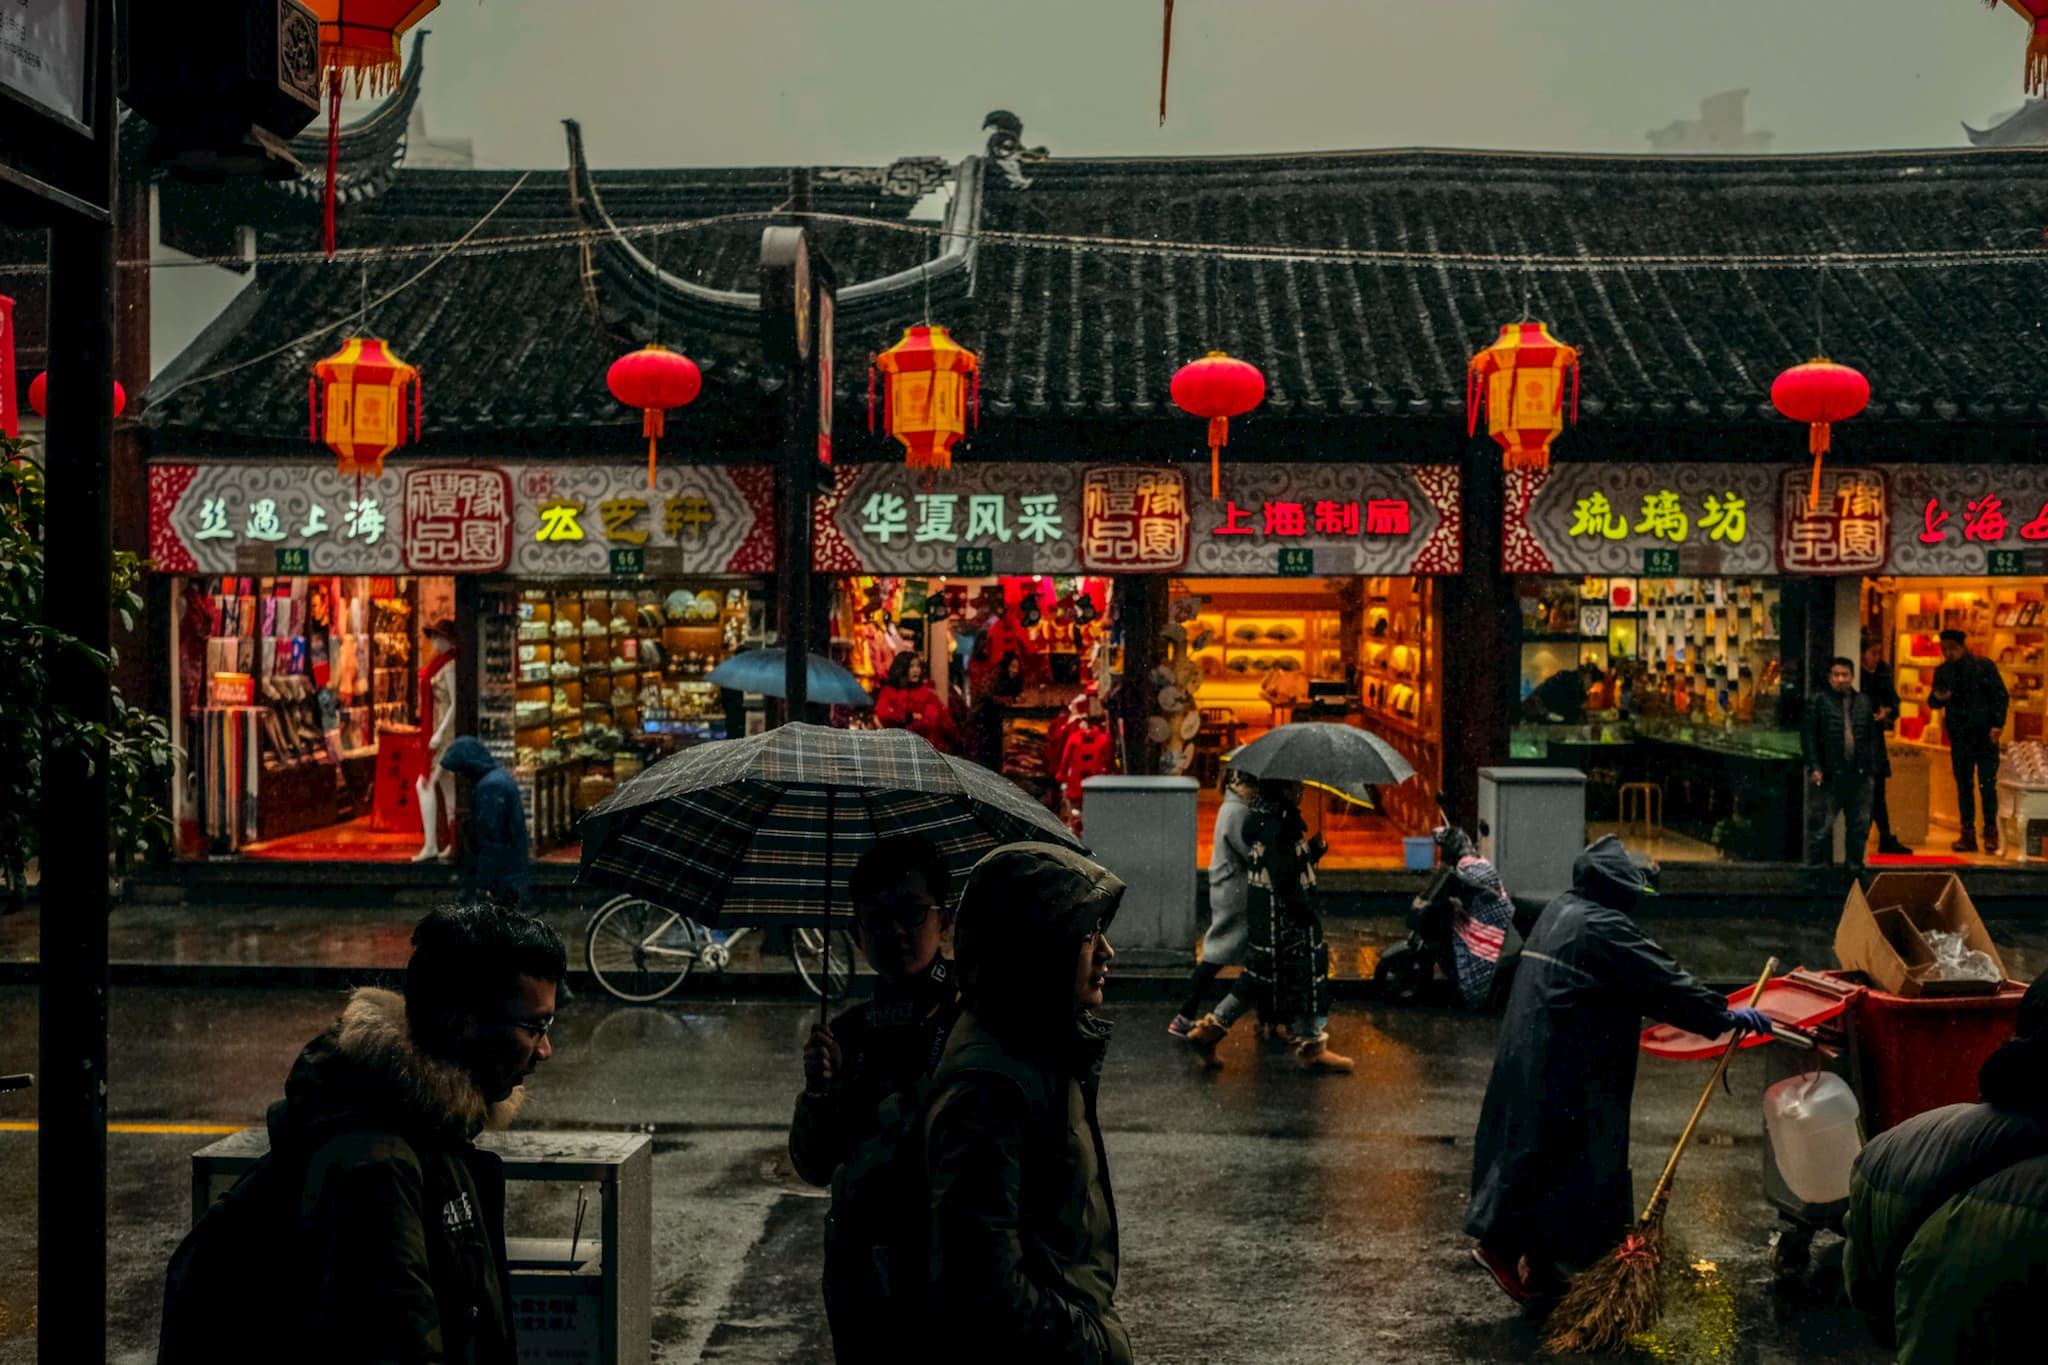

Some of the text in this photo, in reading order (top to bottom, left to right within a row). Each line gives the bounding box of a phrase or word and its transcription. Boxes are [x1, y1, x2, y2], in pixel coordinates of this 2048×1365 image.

[861, 492, 1063, 543] 华夏风采
[1213, 499, 1411, 536] 上海制扇
[1568, 489, 1747, 543] 琉璃坊
[284, 551, 301, 565] 66
[618, 551, 635, 566] 66
[966, 550, 983, 564] 64
[1287, 551, 1304, 565] 64
[1652, 552, 1670, 566] 62
[1996, 552, 2015, 567] 62
